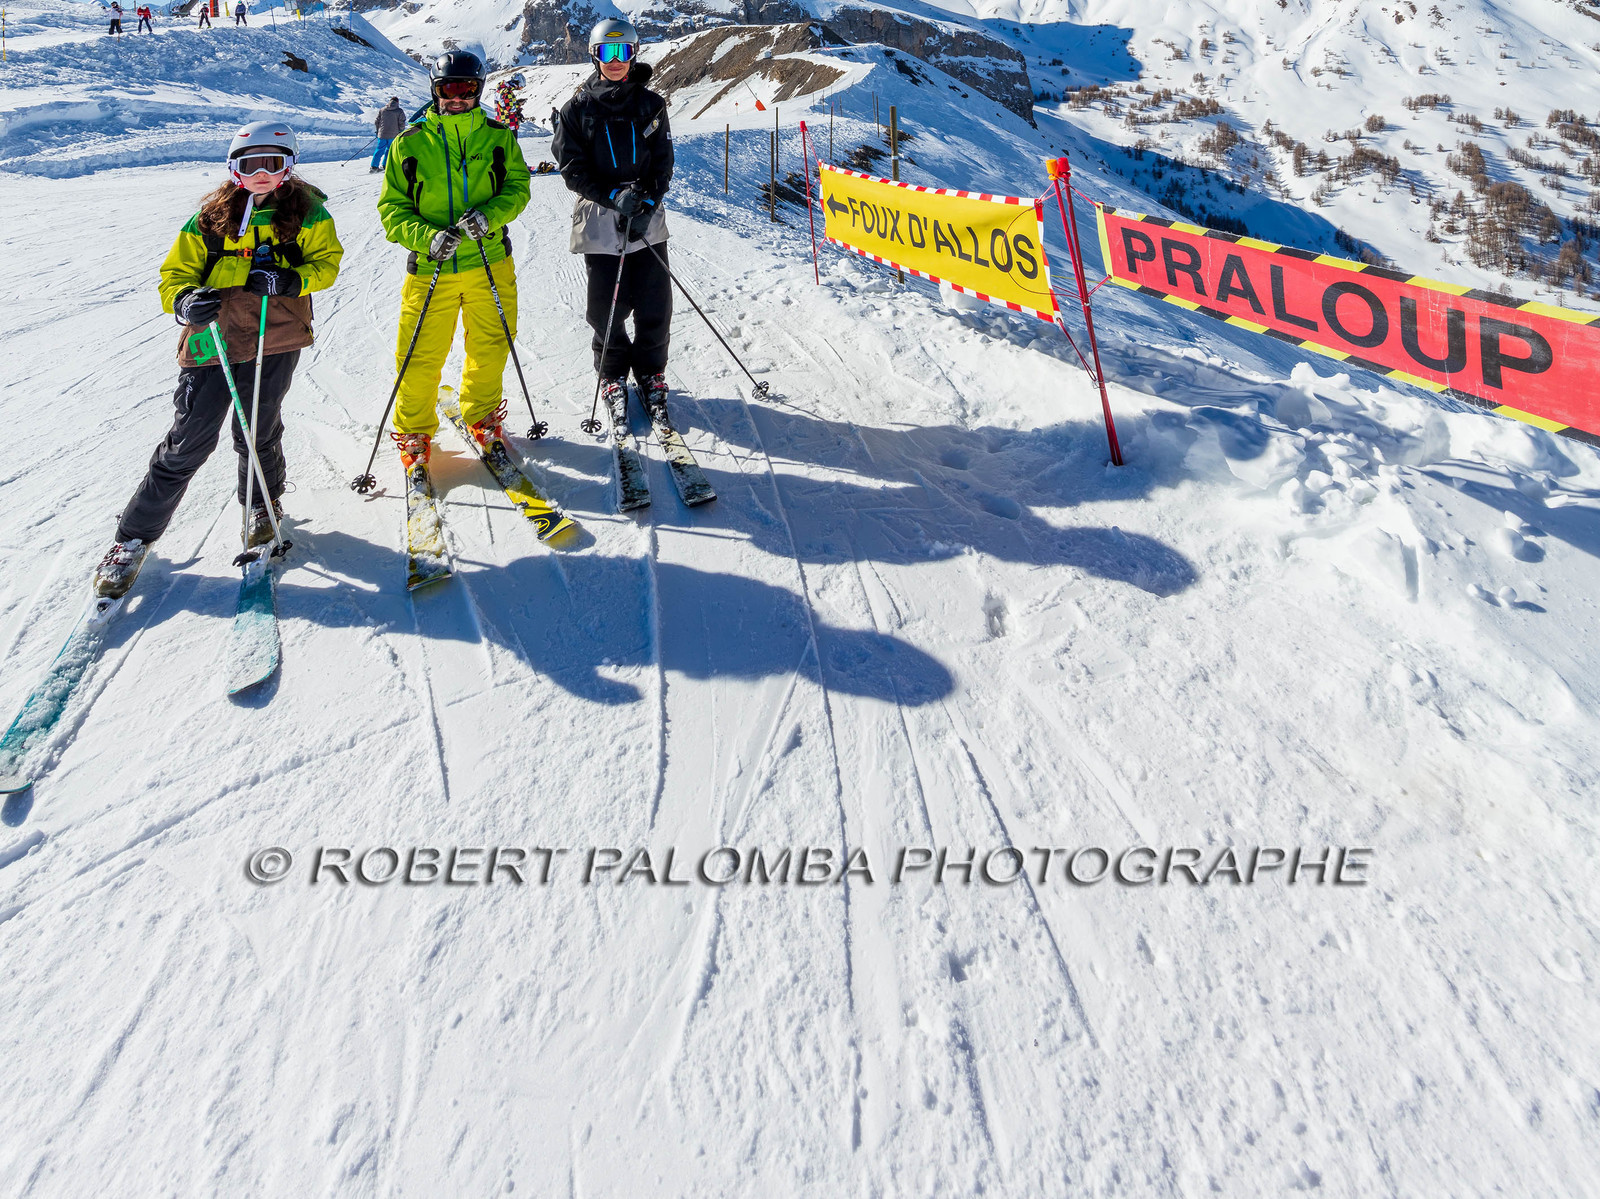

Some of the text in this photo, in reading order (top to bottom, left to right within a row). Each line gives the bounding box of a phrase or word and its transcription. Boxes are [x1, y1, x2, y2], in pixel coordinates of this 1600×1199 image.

[847, 196, 1038, 280] FOUX D'ALLOS
[429, 268, 441, 290] LEKI
[490, 285, 503, 315] VISTA
[1120, 226, 1553, 390] PRALOUP
